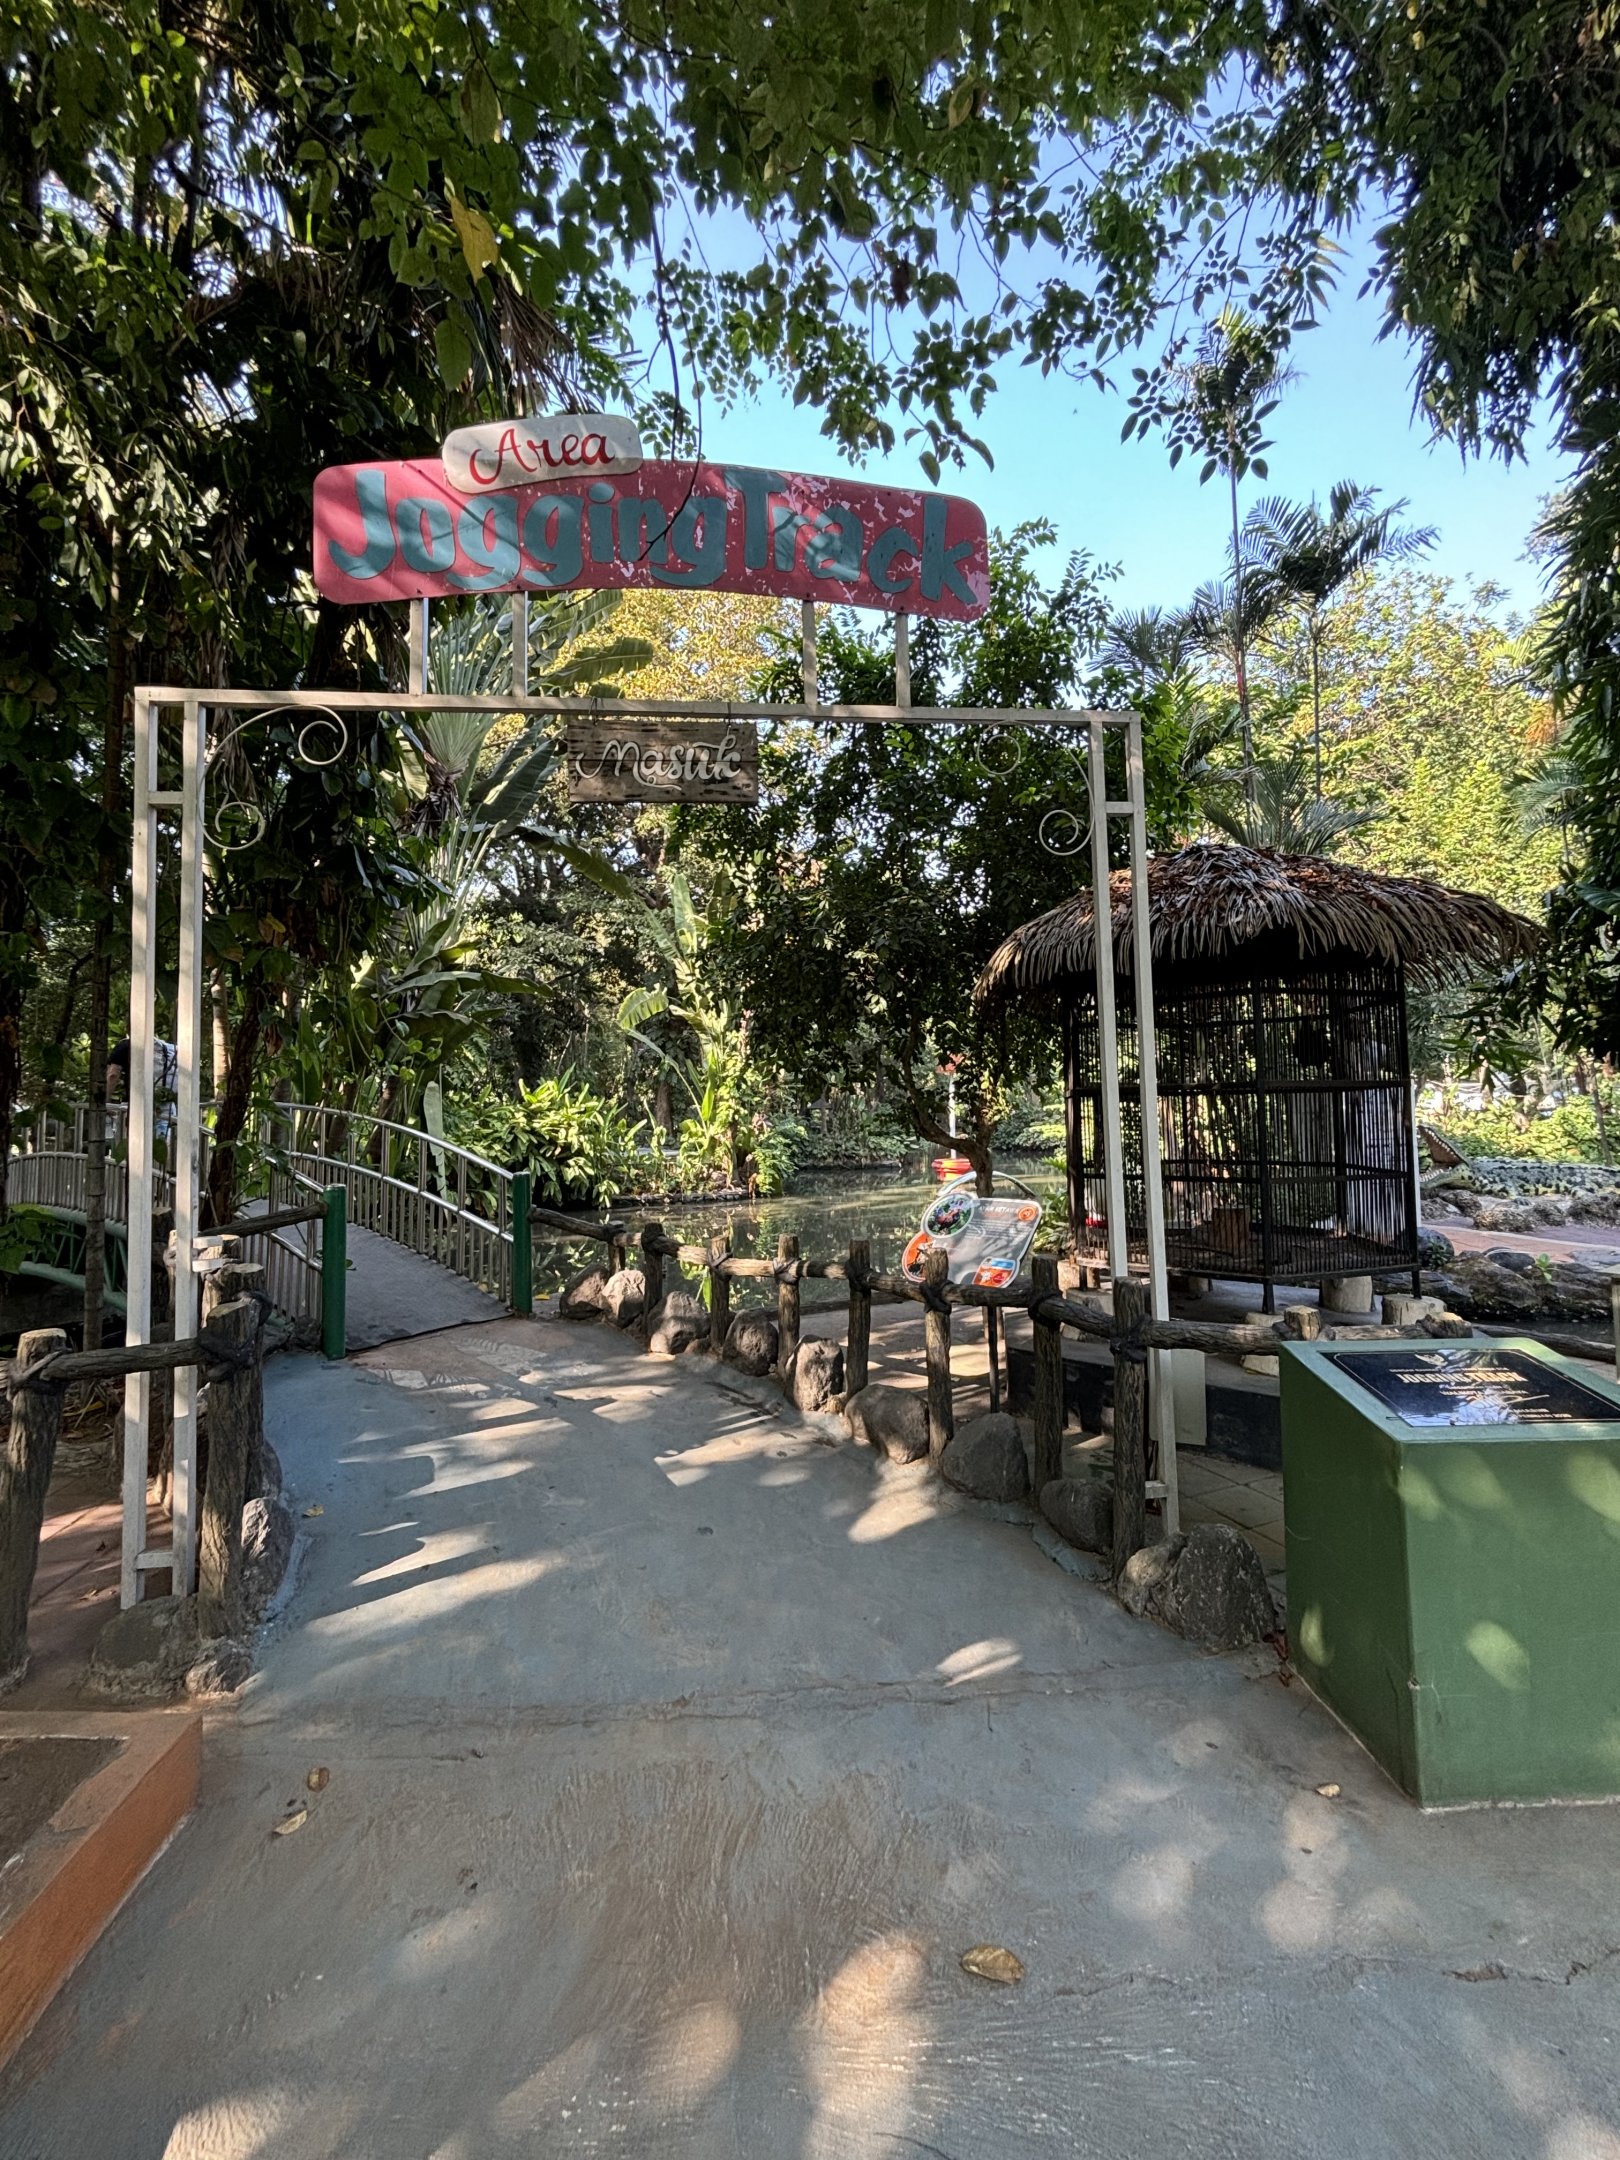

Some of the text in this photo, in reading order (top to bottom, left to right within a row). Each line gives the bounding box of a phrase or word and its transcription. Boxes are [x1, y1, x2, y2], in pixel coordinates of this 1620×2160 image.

[469, 428, 616, 485] Area
[328, 469, 978, 605] Jogging Track
[575, 734, 742, 791] Masuk
[1396, 1371, 1529, 1384] JOGGING TRACK
